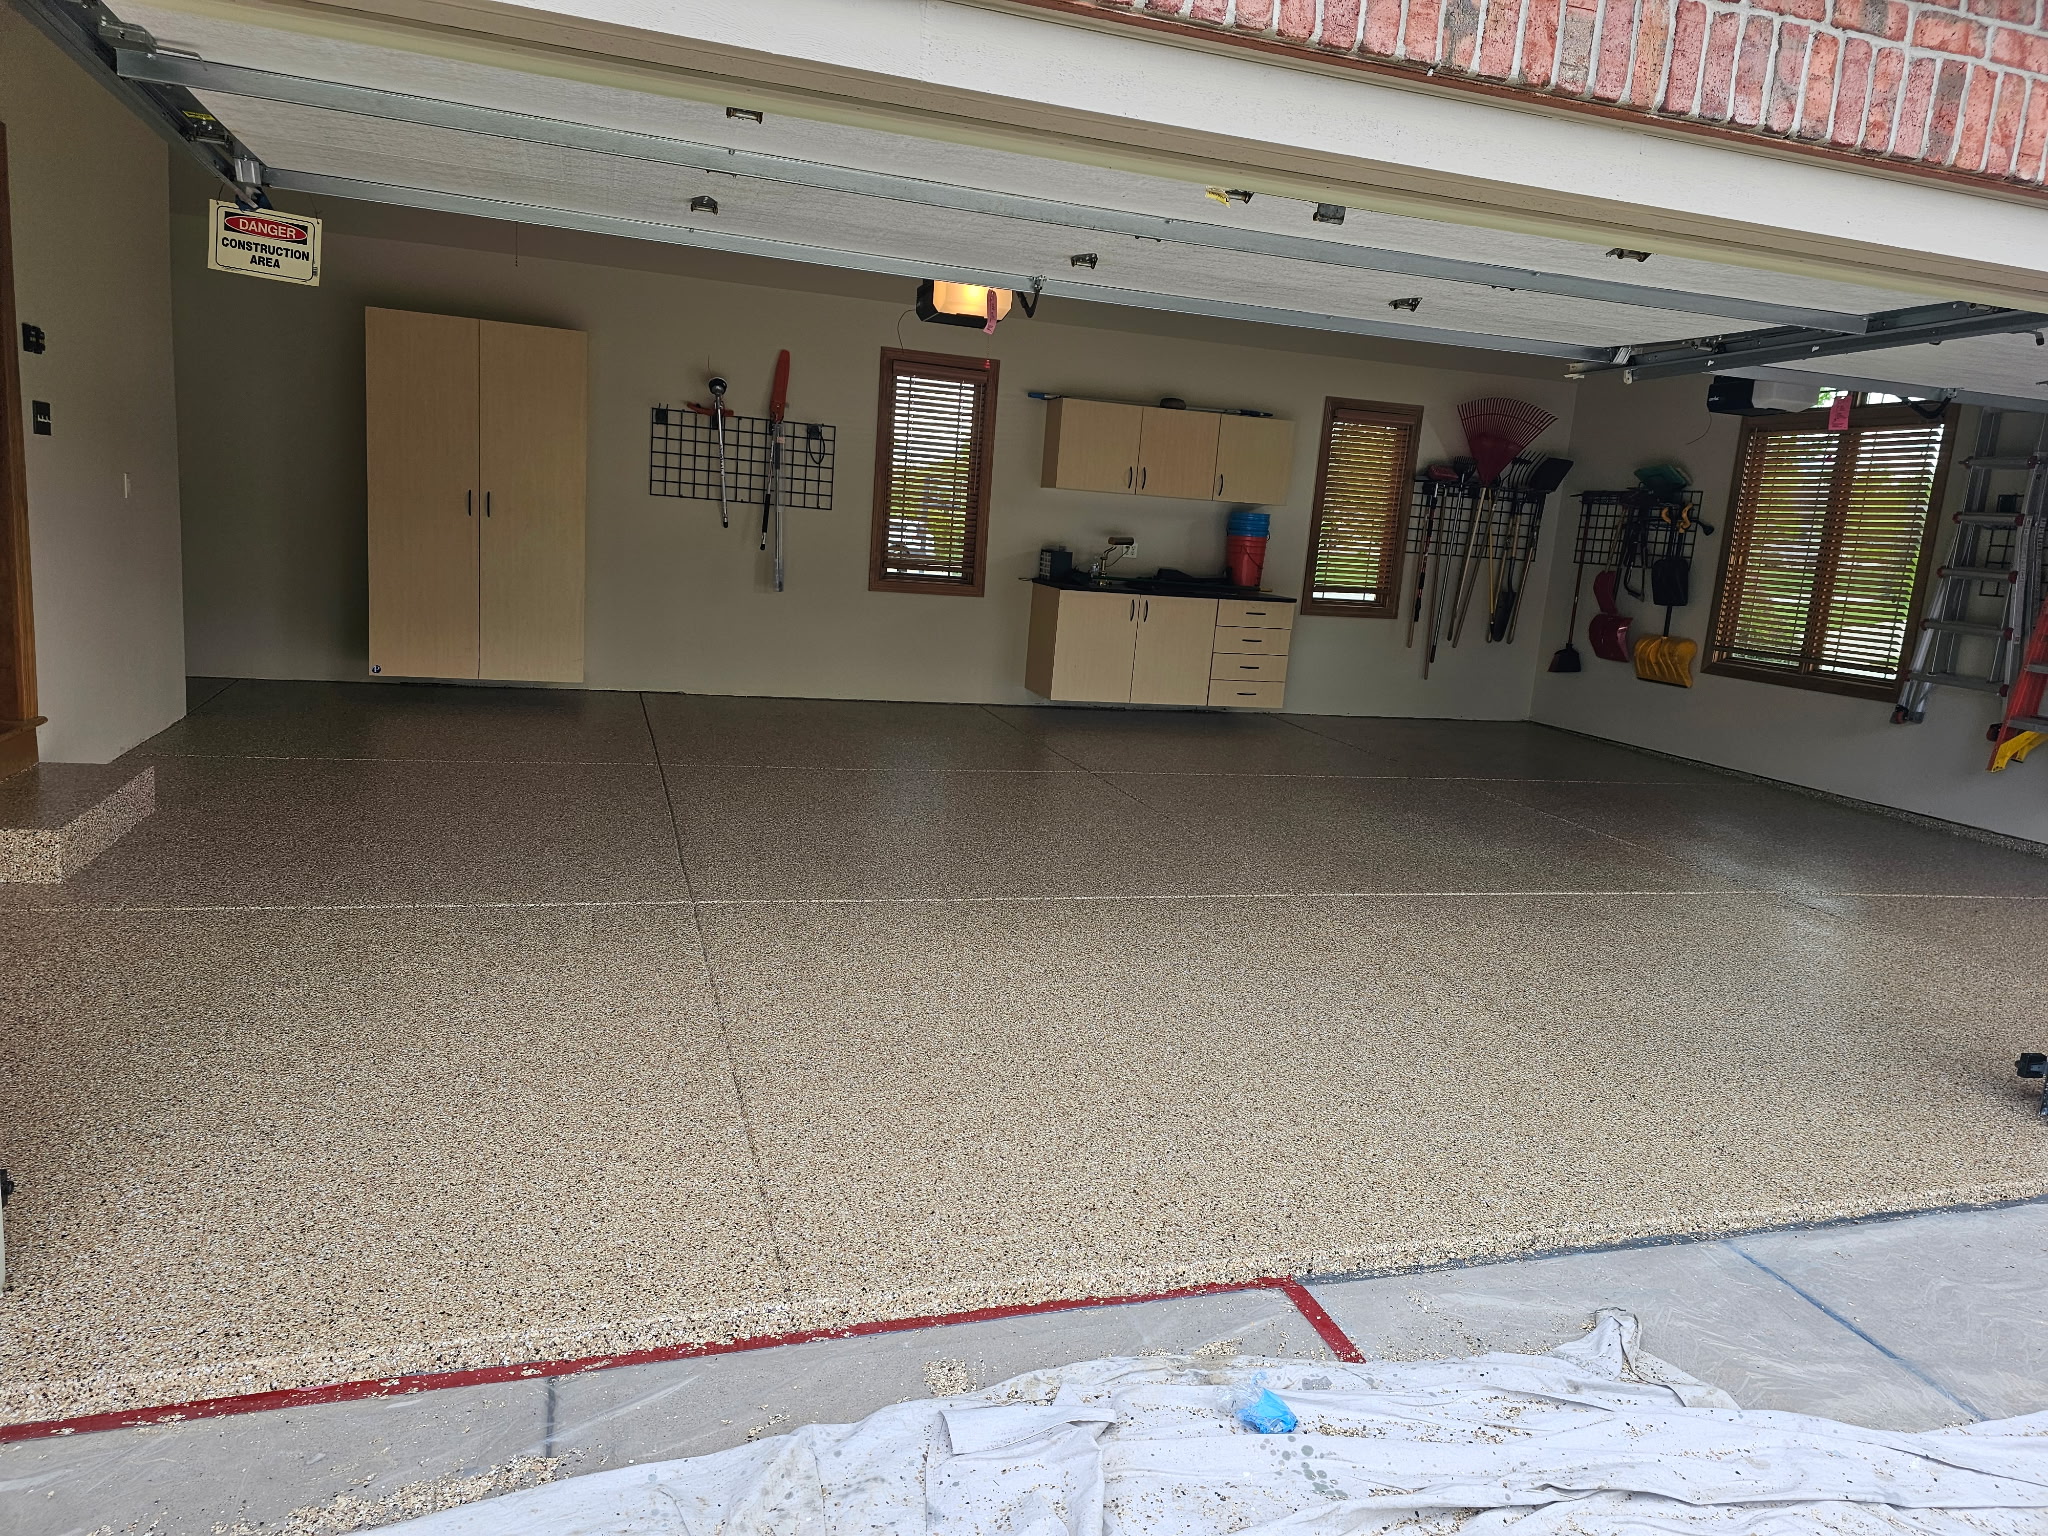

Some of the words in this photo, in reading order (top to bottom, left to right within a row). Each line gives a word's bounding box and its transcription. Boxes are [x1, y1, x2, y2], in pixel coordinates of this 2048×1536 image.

[239, 218, 296, 239] DANGER
[221, 237, 310, 261] CONSTRUCTION
[250, 255, 281, 269] AREA
